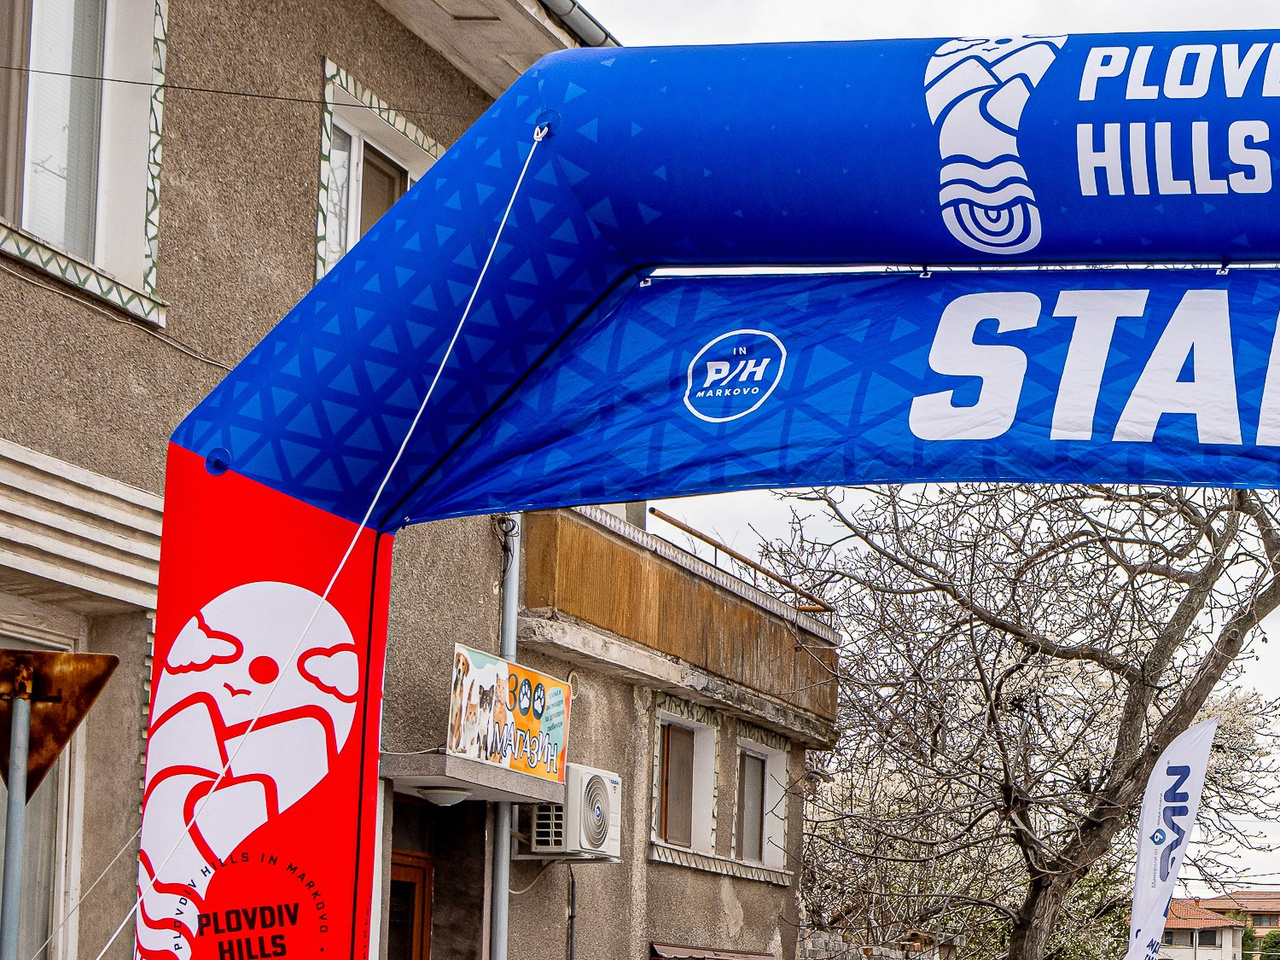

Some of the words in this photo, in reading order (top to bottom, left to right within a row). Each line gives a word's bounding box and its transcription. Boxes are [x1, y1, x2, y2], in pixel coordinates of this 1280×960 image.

[1076, 119, 1273, 196] HILLS
[732, 346, 748, 356] IN
[702, 357, 772, 389] P/H
[695, 386, 760, 398] MARKOVO
[491, 721, 558, 774] МАГАЗИН
[173, 879, 197, 951] PLOVDIV
[200, 852, 250, 878] HILLS
[260, 853, 279, 866] IN
[286, 862, 329, 934] MARKOVO
[197, 902, 300, 937] PLOVDIV
